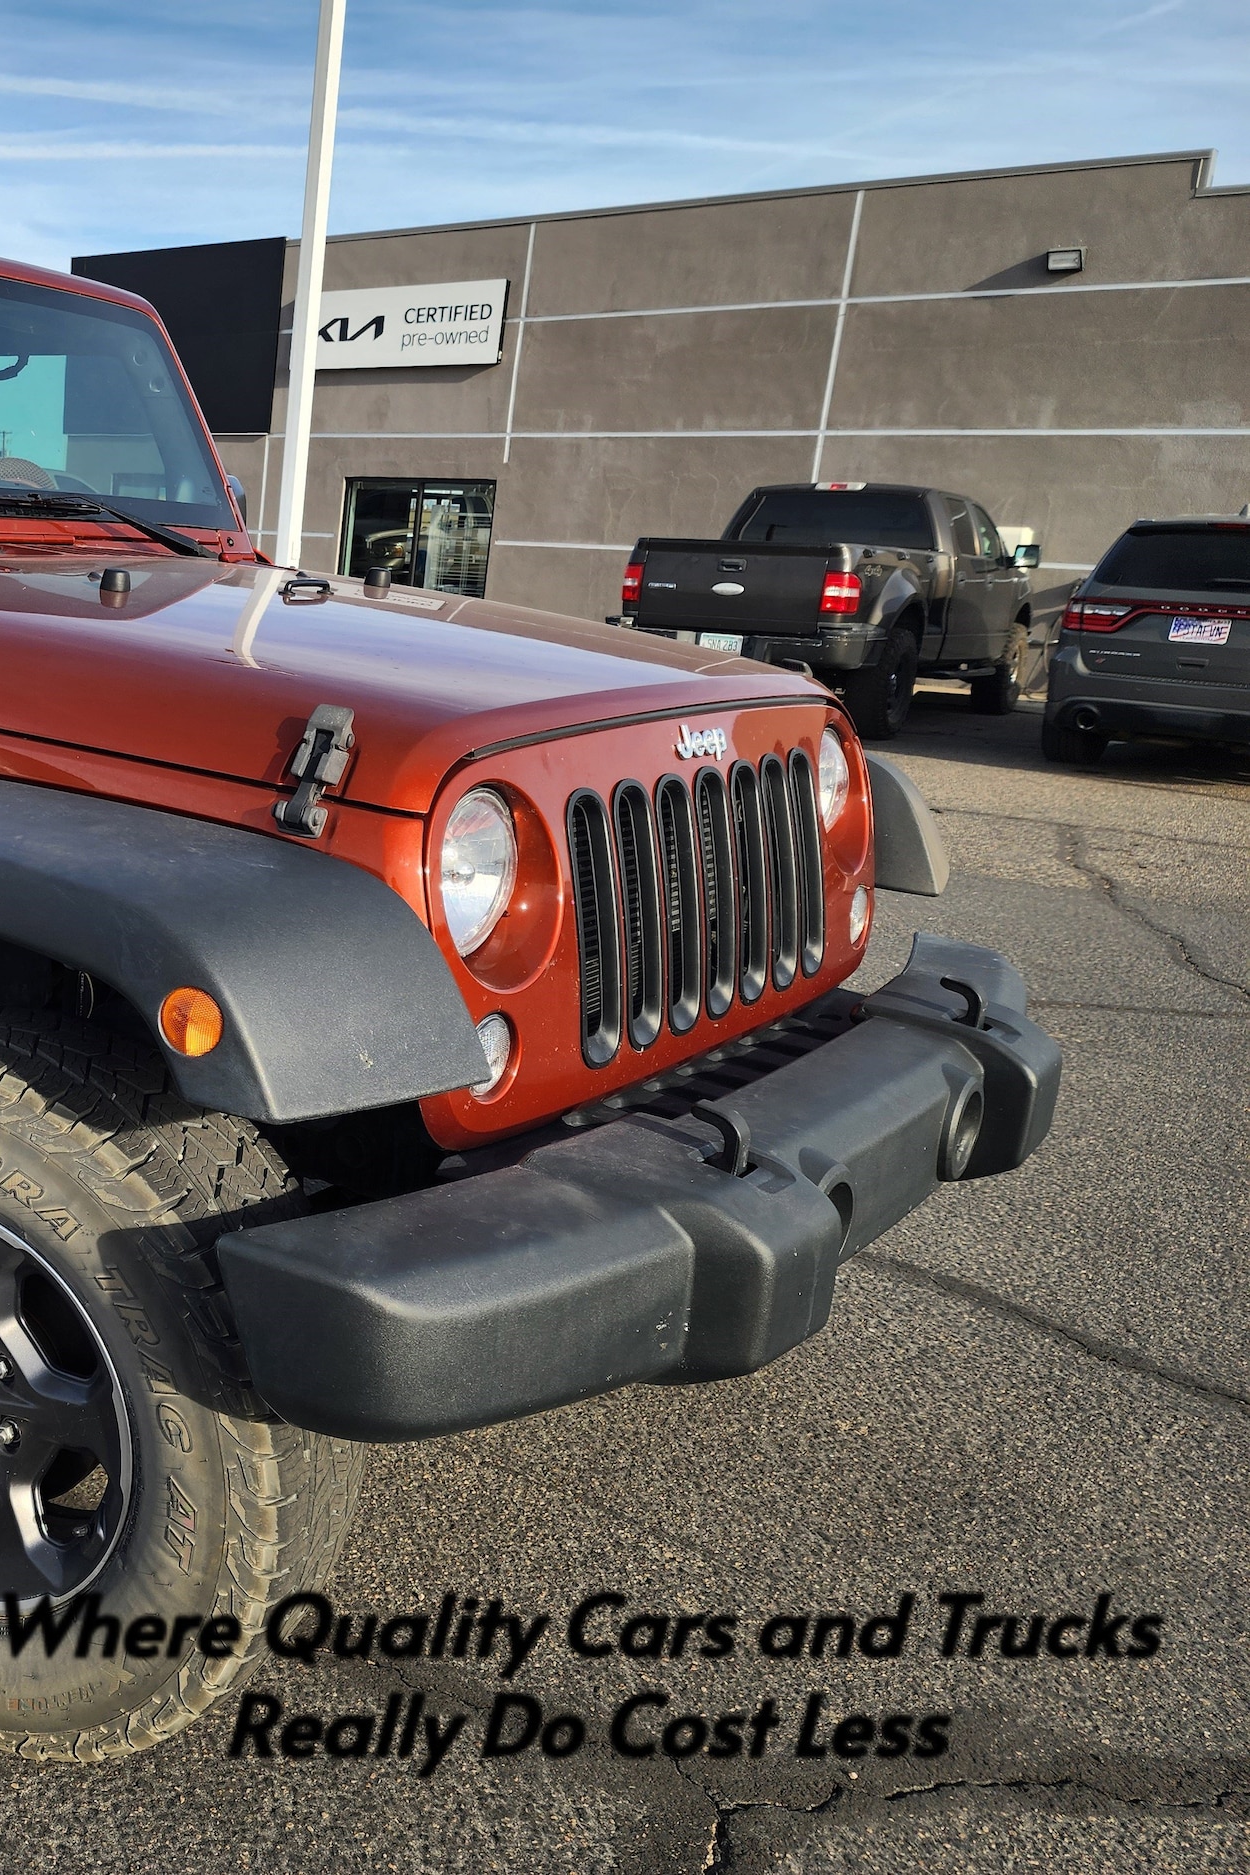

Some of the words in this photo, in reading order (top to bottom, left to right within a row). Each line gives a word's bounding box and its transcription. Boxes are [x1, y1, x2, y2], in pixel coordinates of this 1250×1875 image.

[404, 303, 493, 324] CERTIFIED
[401, 325, 489, 351] pre-owned
[672, 724, 728, 761] Jeep
[94, 1263, 194, 1455] TRAC
